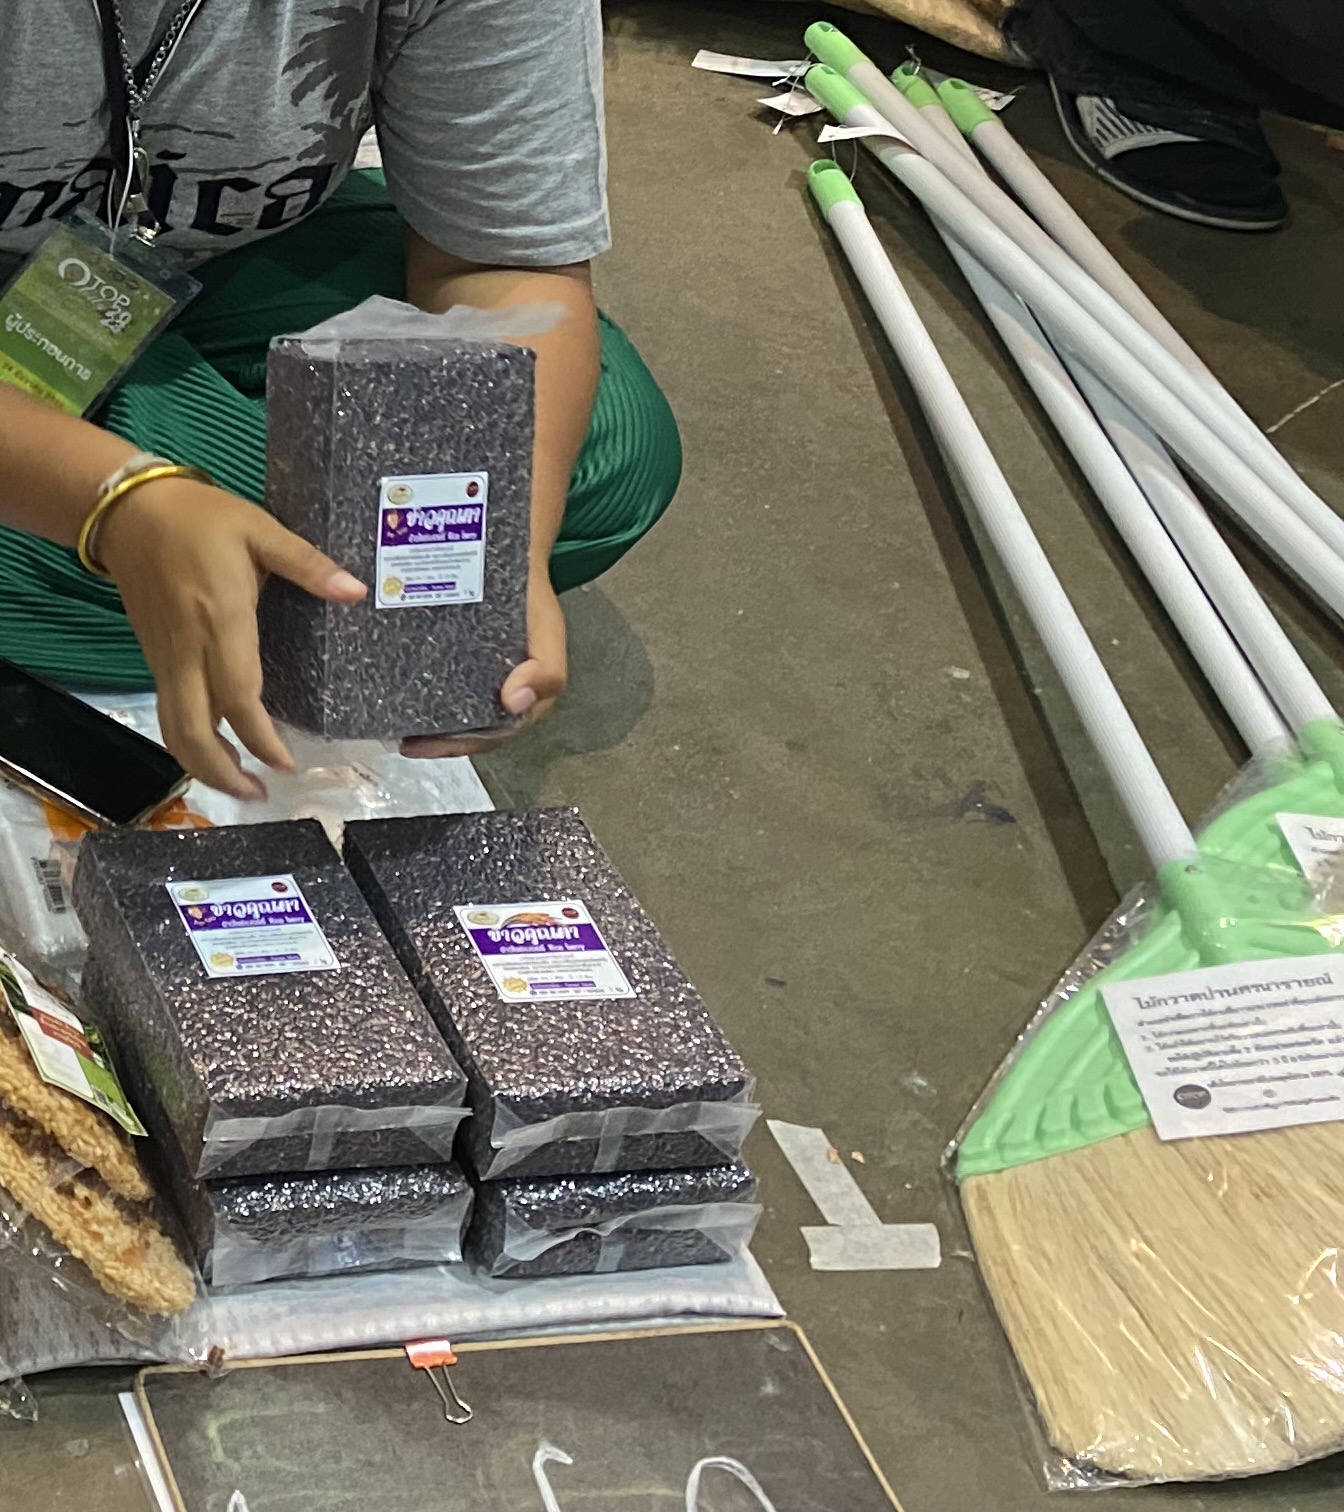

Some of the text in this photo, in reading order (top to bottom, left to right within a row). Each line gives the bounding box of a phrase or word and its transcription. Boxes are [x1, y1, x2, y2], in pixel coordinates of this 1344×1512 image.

[4, 313, 92, 381] ผู้ประกอบการ
